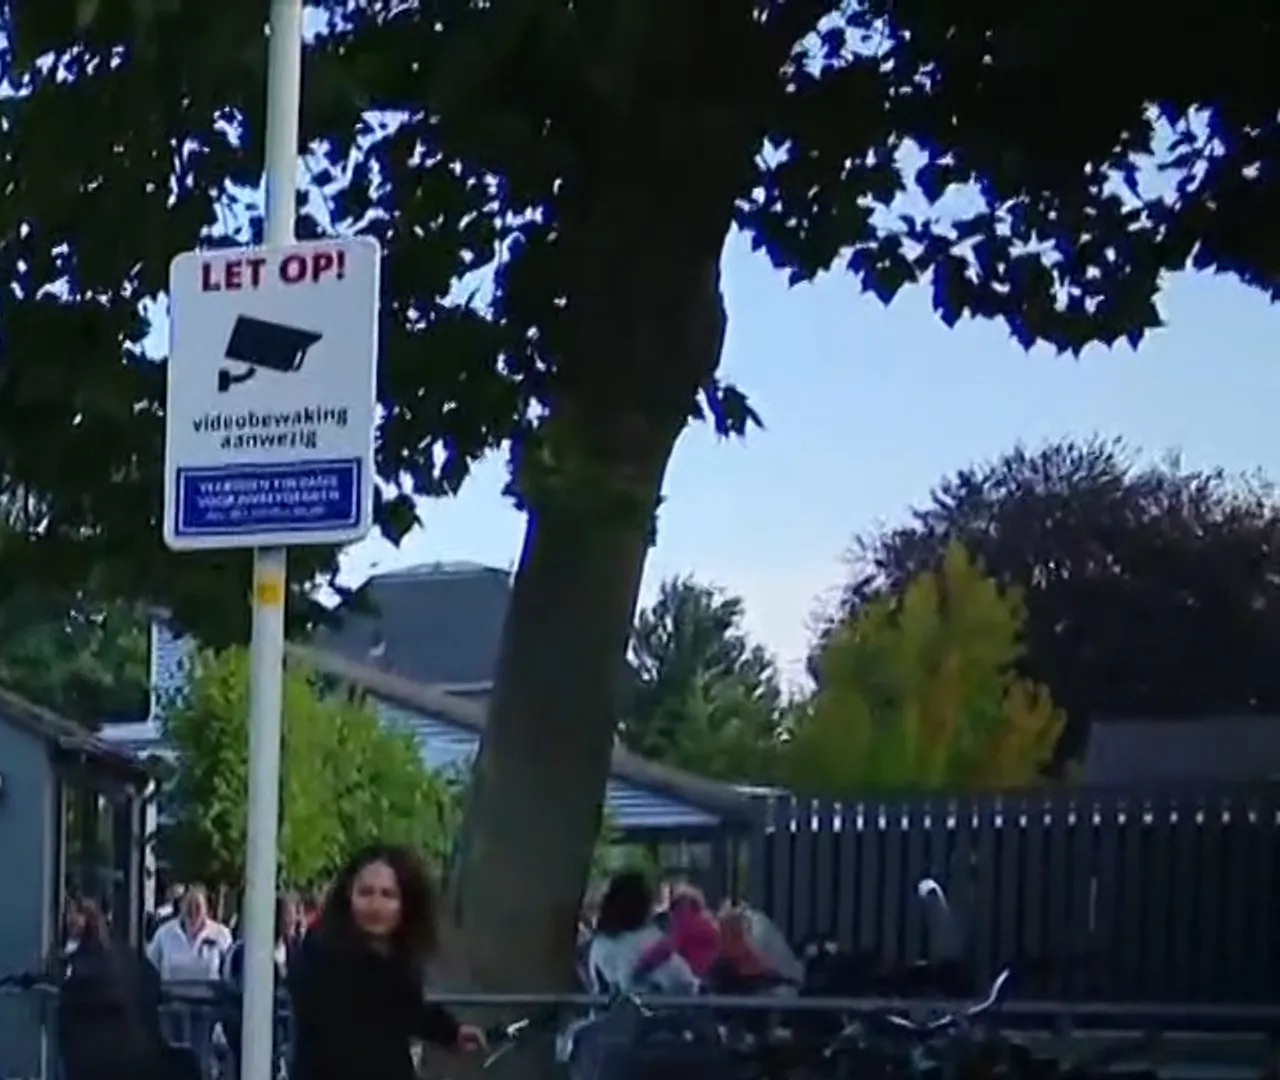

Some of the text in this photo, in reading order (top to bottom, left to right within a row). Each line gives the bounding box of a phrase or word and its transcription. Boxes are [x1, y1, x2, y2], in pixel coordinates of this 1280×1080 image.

[201, 249, 346, 293] LET OP!
[192, 405, 348, 432] videobewaking
[220, 428, 318, 449] aanwezig
